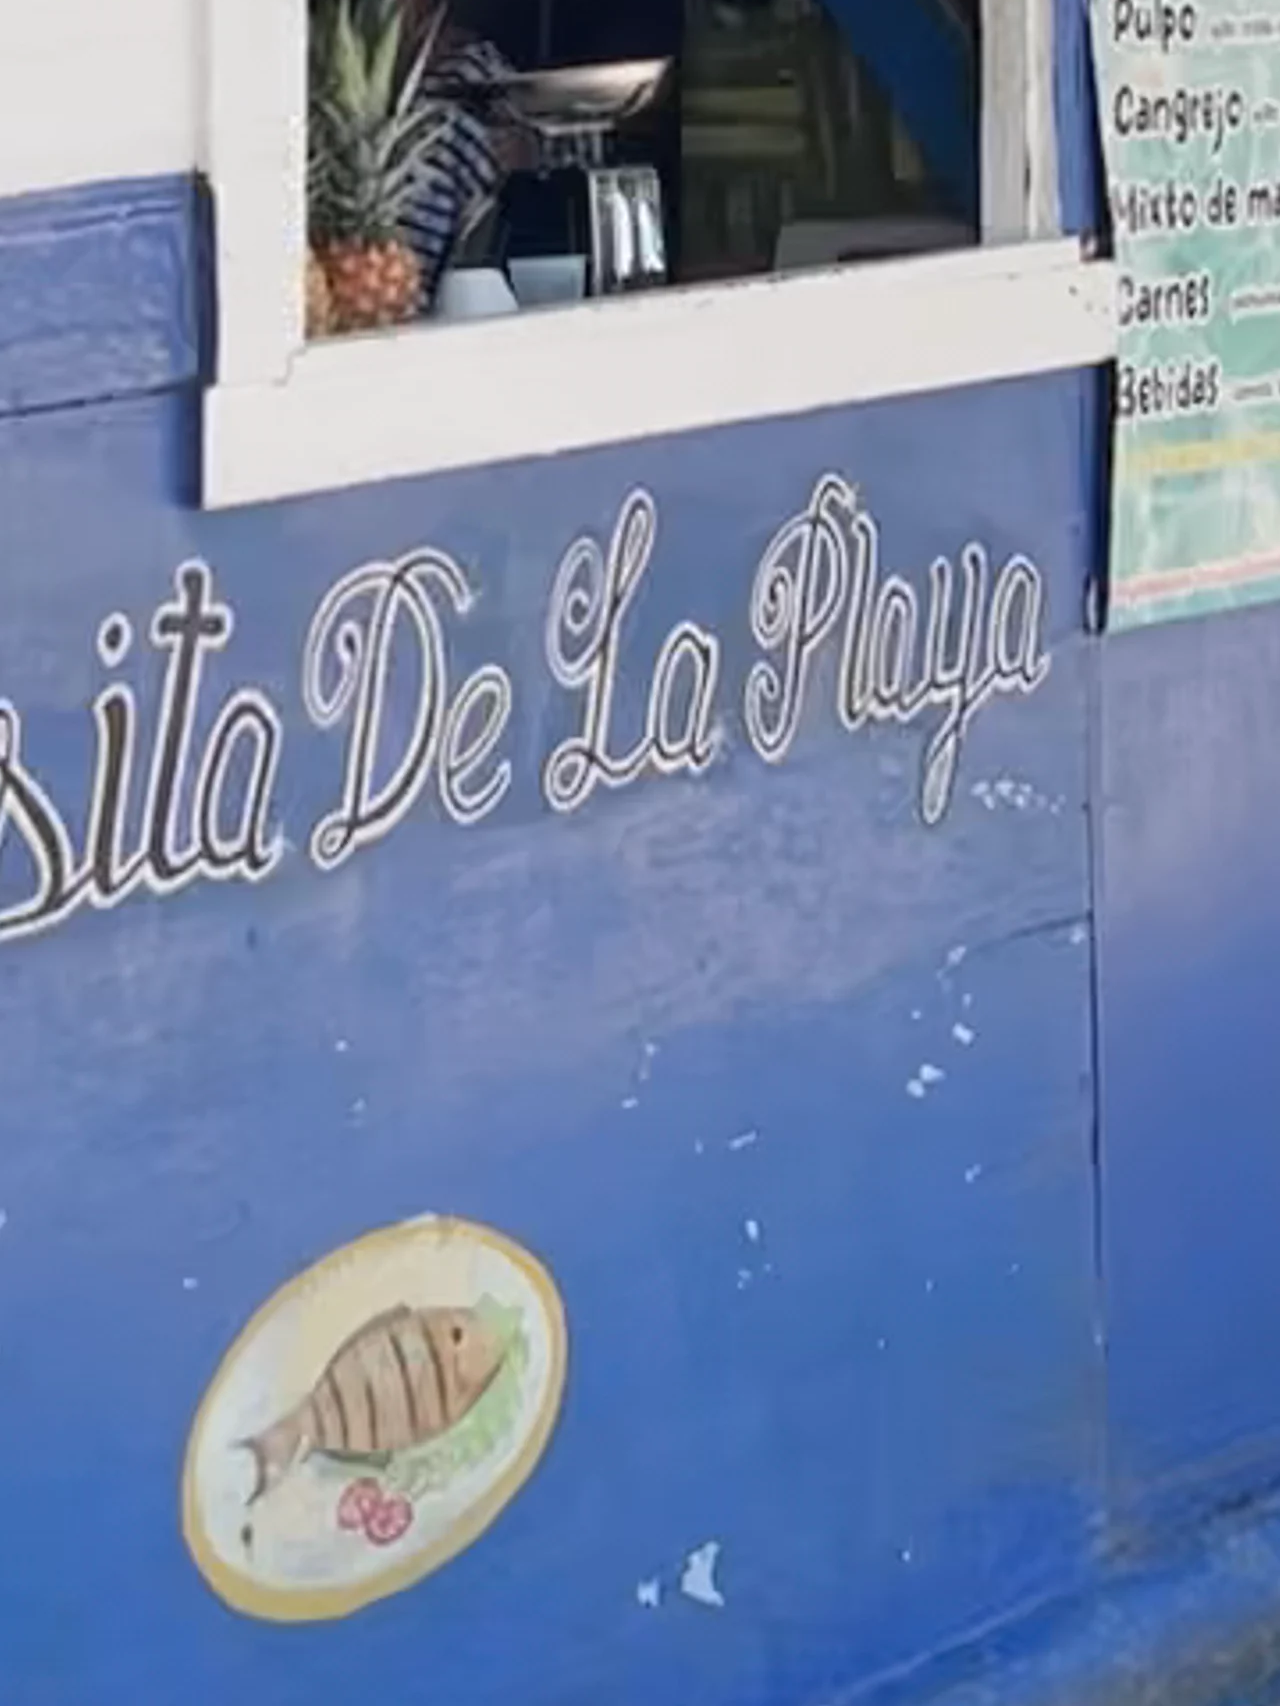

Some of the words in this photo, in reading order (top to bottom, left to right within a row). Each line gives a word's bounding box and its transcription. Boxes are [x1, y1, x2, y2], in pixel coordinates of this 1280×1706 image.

[1114, 86, 1244, 154] Cangrejo
[1206, 178, 1238, 225] de
[1119, 276, 1210, 326] Carnes
[1119, 364, 1219, 416] Bebidas
[302, 544, 512, 872] De
[542, 486, 723, 814] La
[742, 470, 1054, 826] Playa
